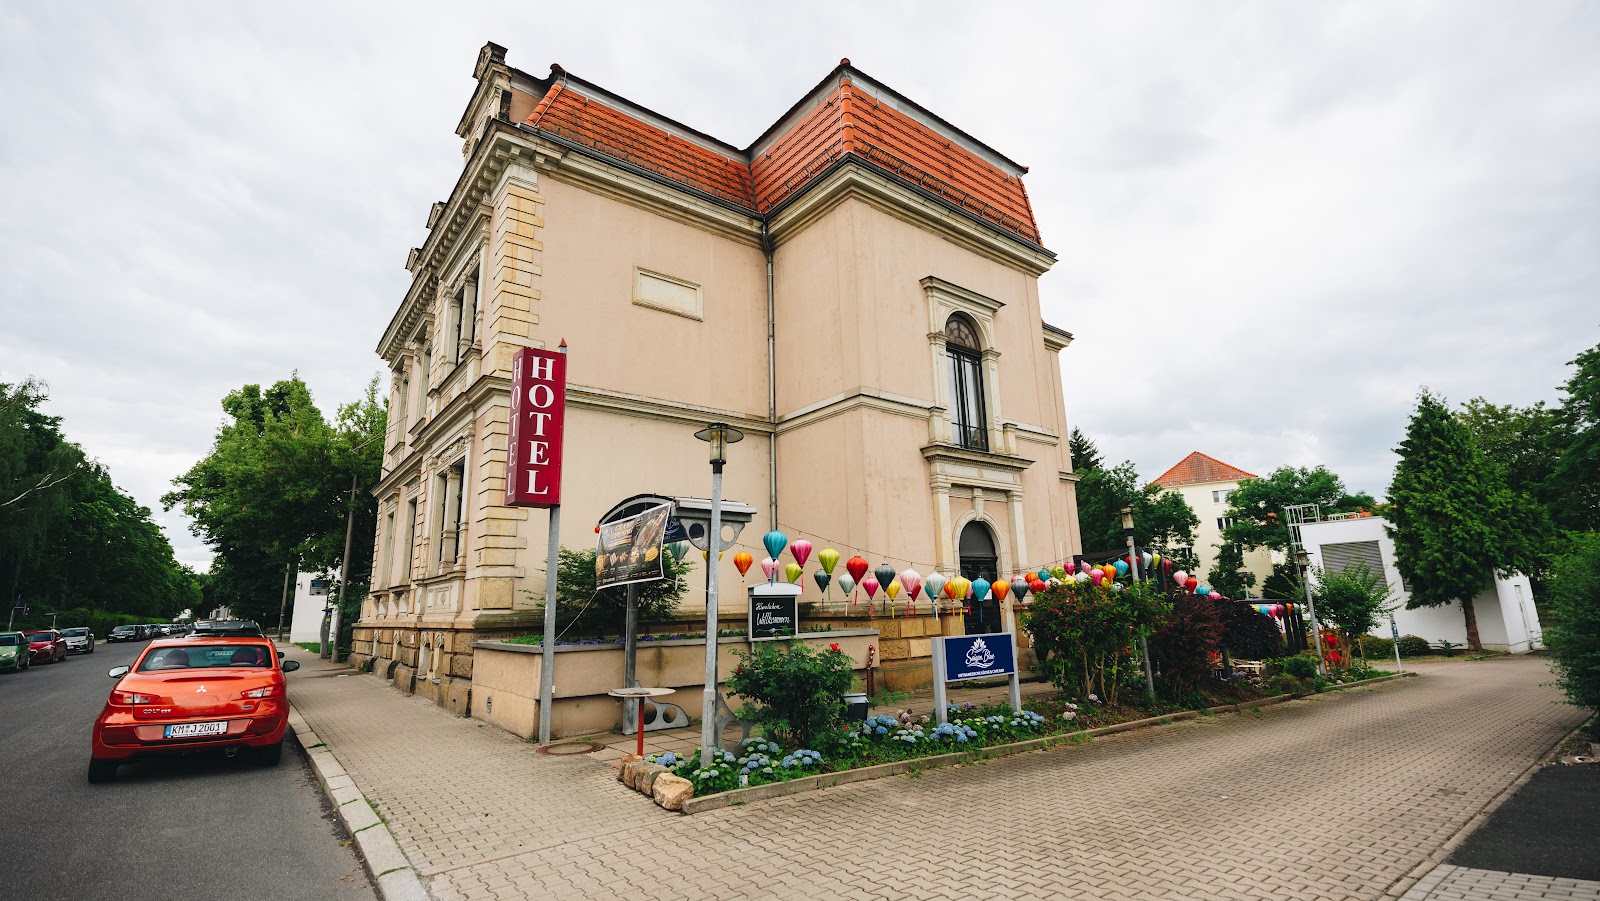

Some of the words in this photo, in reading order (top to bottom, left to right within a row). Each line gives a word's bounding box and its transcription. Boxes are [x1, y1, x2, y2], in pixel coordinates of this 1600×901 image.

[507, 357, 523, 496] HOTEL
[525, 355, 556, 495] HOTEL
[756, 611, 791, 626] Willkommen
[964, 648, 983, 665] Saigon
[171, 725, 185, 735] KM
[198, 723, 220, 733] 2001
